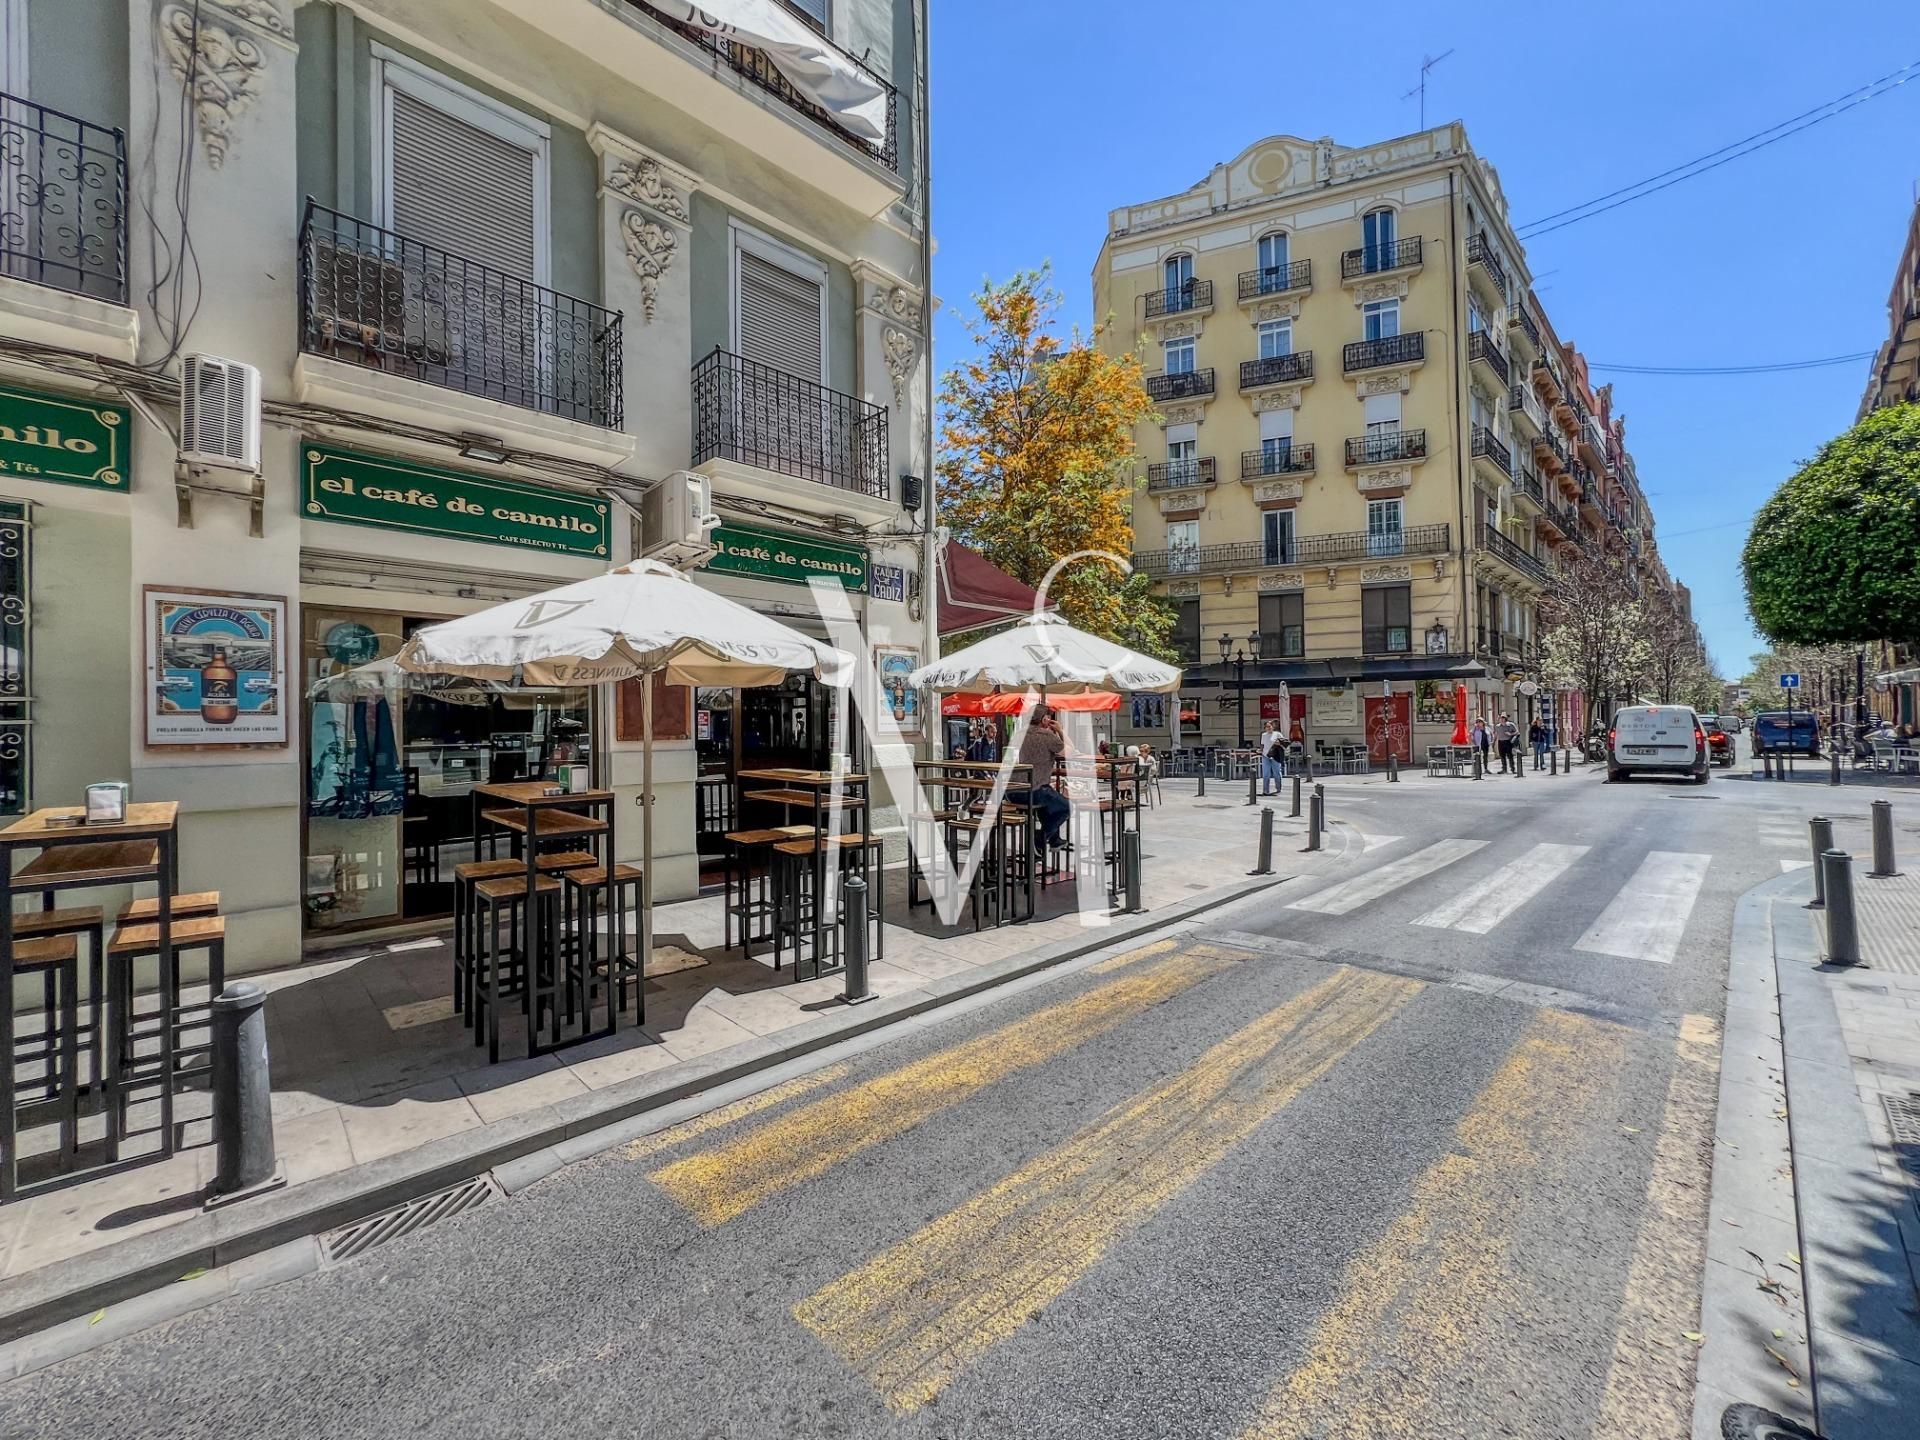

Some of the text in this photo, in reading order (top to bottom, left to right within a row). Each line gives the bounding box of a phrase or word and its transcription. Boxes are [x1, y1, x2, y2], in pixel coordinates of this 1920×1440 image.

[12, 461, 40, 474] Tés
[320, 476, 356, 496] el
[361, 487, 439, 509] café
[446, 496, 485, 516] de
[491, 508, 598, 535] camilo
[519, 537, 551, 548] SELECTO
[709, 541, 862, 576] el café de camilo
[874, 566, 900, 579] CALLE
[873, 584, 901, 602] CADIZ
